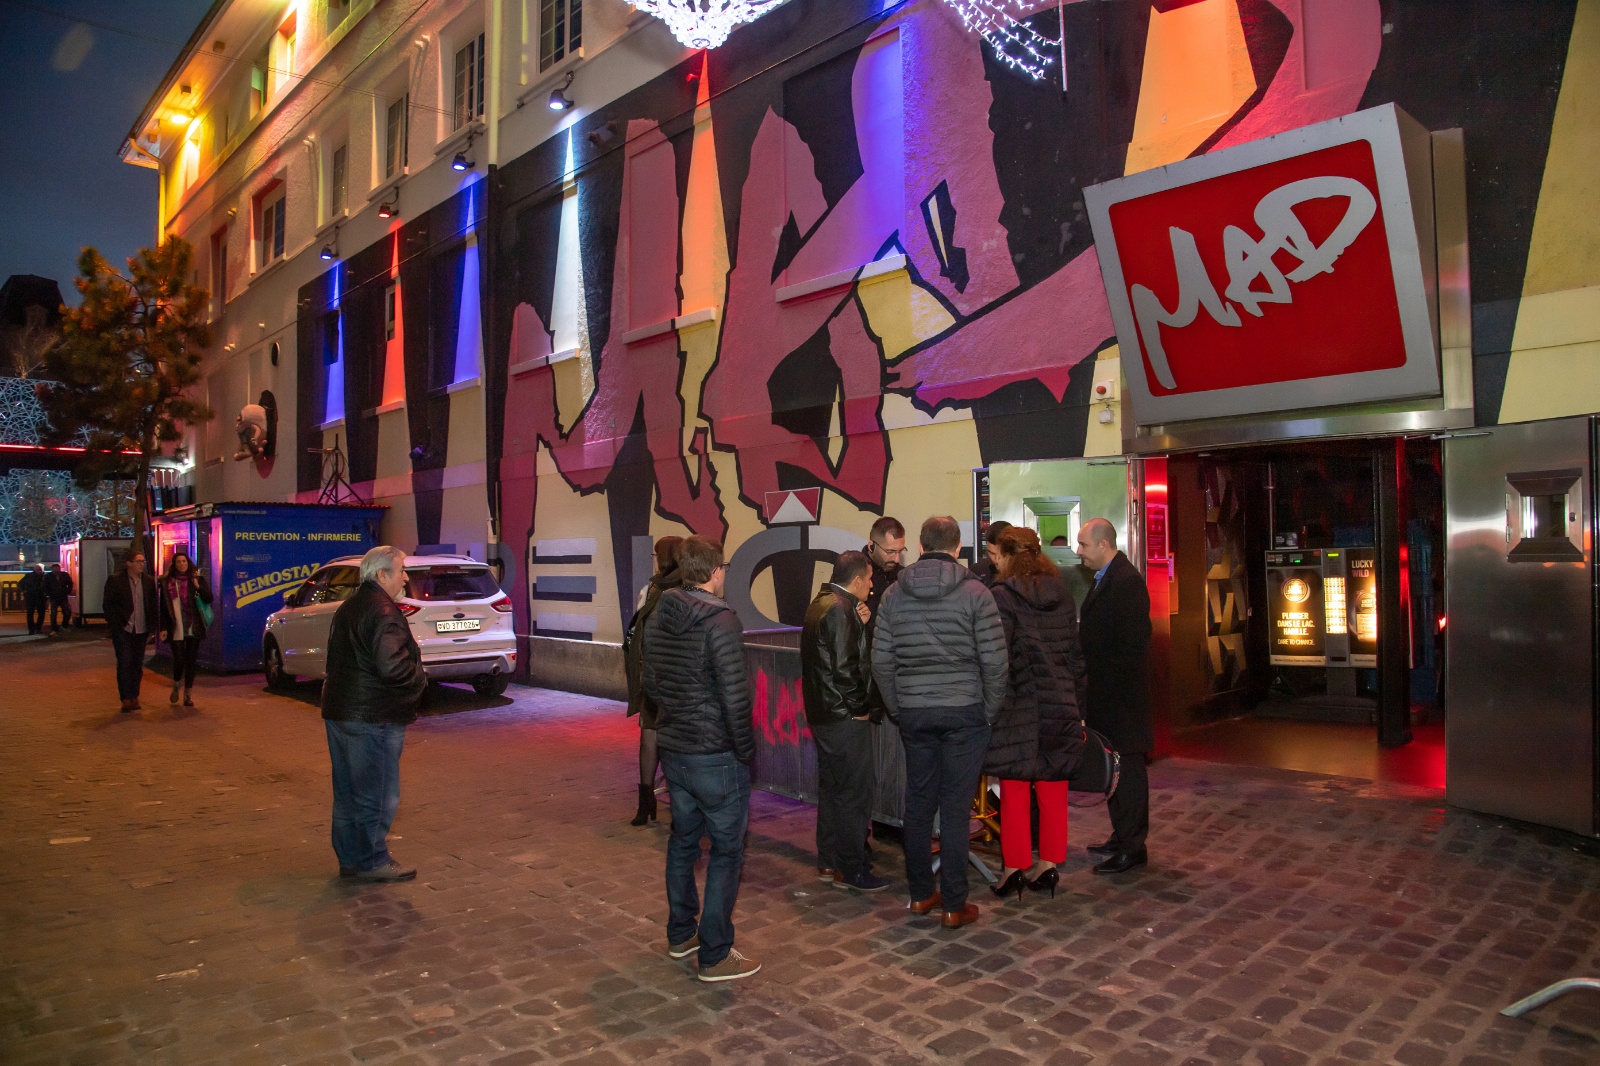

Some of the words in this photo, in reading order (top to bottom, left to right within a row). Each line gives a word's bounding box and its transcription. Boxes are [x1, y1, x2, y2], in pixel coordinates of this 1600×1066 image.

[1130, 175, 1378, 390] MAD
[235, 532, 300, 541] PREVENTION
[307, 533, 362, 542] INFIRMERIE
[1351, 560, 1374, 569] LUCKY
[1351, 569, 1370, 578] WILD
[234, 562, 321, 599] HEMOSTAZ
[442, 622, 451, 630] VD
[452, 621, 476, 630] 377026
